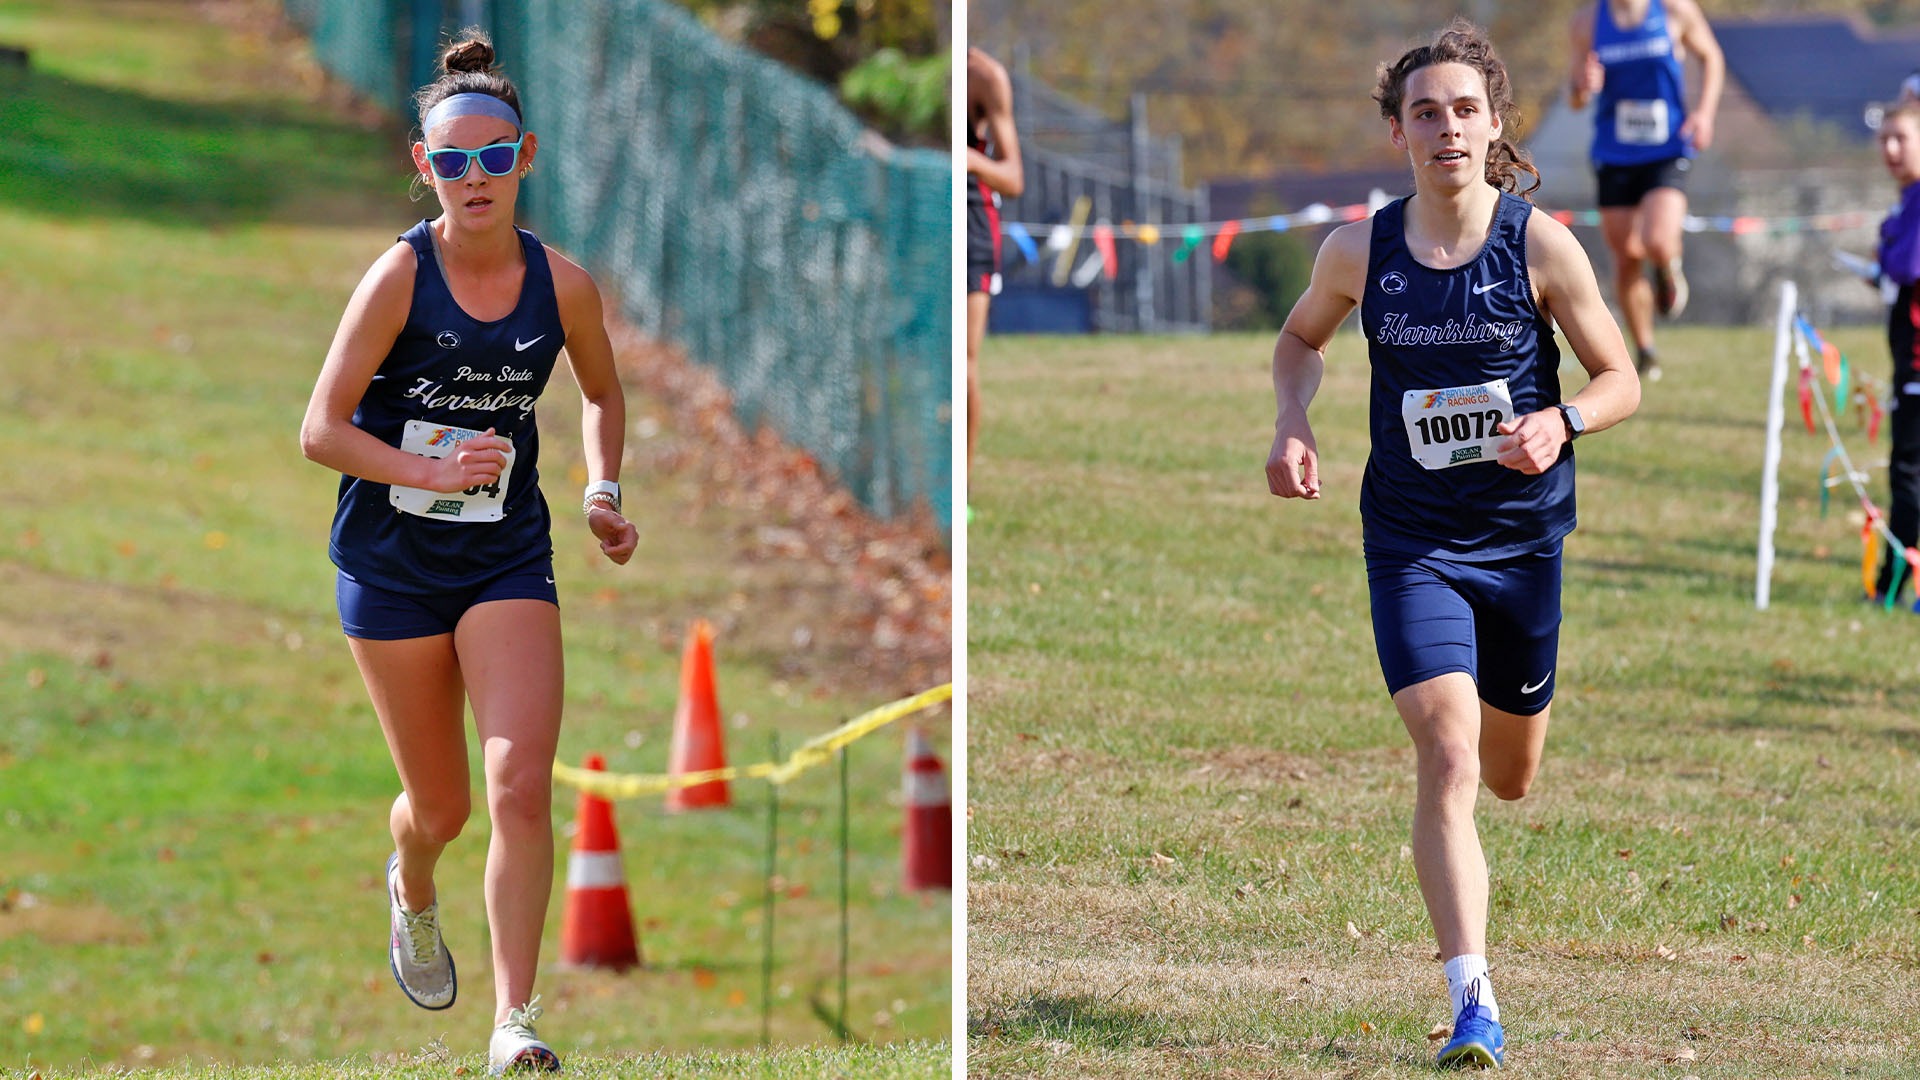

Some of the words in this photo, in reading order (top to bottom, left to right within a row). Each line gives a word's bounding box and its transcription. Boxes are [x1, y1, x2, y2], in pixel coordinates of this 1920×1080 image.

[1377, 312, 1523, 352] Harrisburg
[453, 366, 492, 381] Penn
[497, 366, 532, 382] State
[403, 377, 537, 420] Harrisburg
[1446, 389, 1465, 399] BRYN
[1465, 386, 1488, 397] MAWR
[1448, 396, 1477, 407] RACING
[1478, 394, 1489, 403] CO
[1415, 409, 1503, 445] 10072
